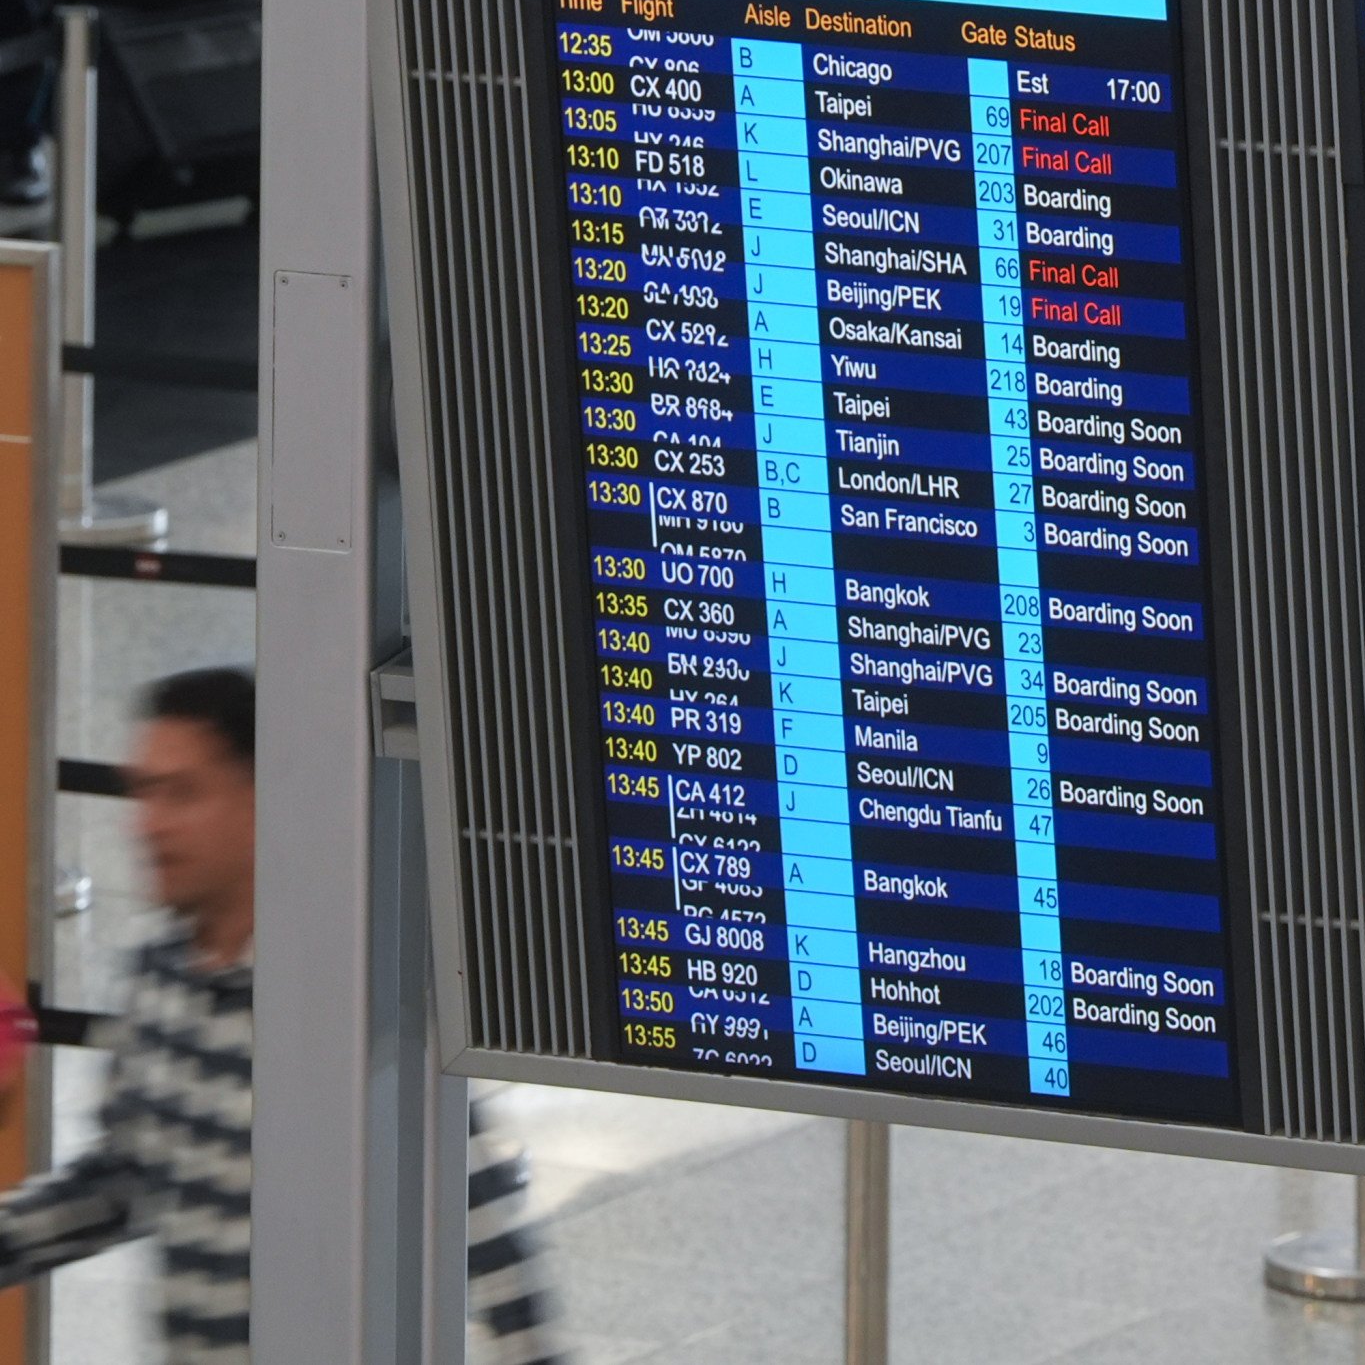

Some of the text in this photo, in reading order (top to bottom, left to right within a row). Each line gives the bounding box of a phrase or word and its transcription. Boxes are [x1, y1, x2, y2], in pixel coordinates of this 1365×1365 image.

[743, 2, 792, 29] Aisle
[804, 6, 913, 39] Destination
[960, 19, 1008, 47] Gate
[1013, 24, 1077, 53] Status
[559, 30, 1162, 105] 12:35 Chicago Est 17:00
[561, 68, 1111, 138] 13:00 CX 400 A Taipei 69 Final Call
[821, 203, 921, 235] Seoul/ICN
[840, 503, 979, 539] San Francisco
[595, 591, 1043, 656] 13:35 CX 360 A Shanghai/PVG 23
[858, 796, 1003, 832] Chengdu Tianfu
[619, 951, 1217, 1034] 13:45 HB 920 D Hohhot 202 Boarding Soon
